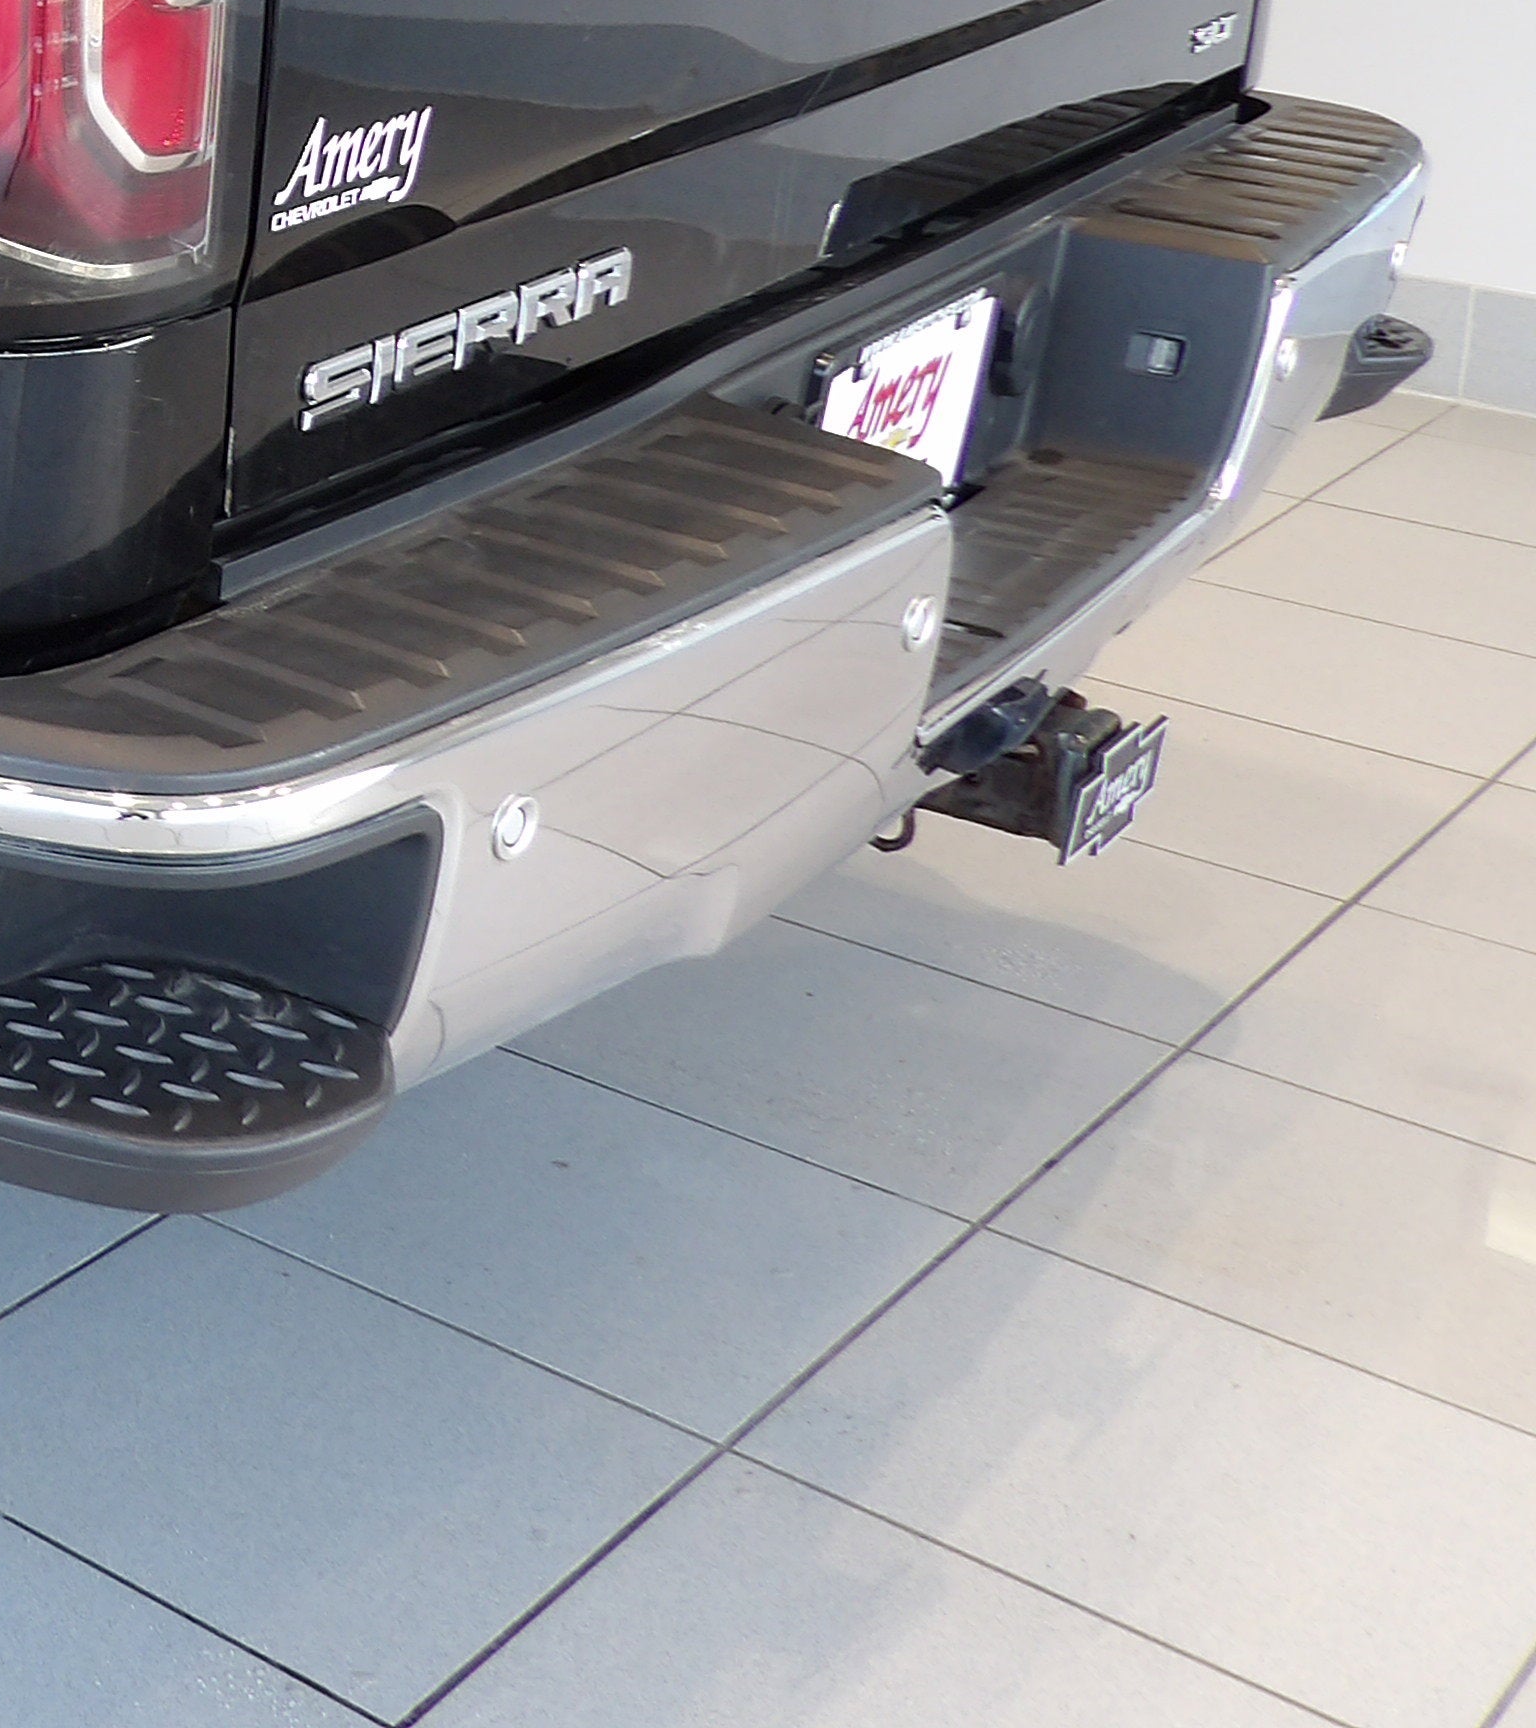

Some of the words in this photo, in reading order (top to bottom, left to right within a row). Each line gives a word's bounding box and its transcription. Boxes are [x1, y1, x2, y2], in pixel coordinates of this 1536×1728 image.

[274, 105, 433, 206] Amery
[270, 187, 361, 232] CHEVROLET
[298, 246, 633, 432] SIERRA
[846, 351, 953, 450] Amery
[1085, 749, 1153, 826] Amery
